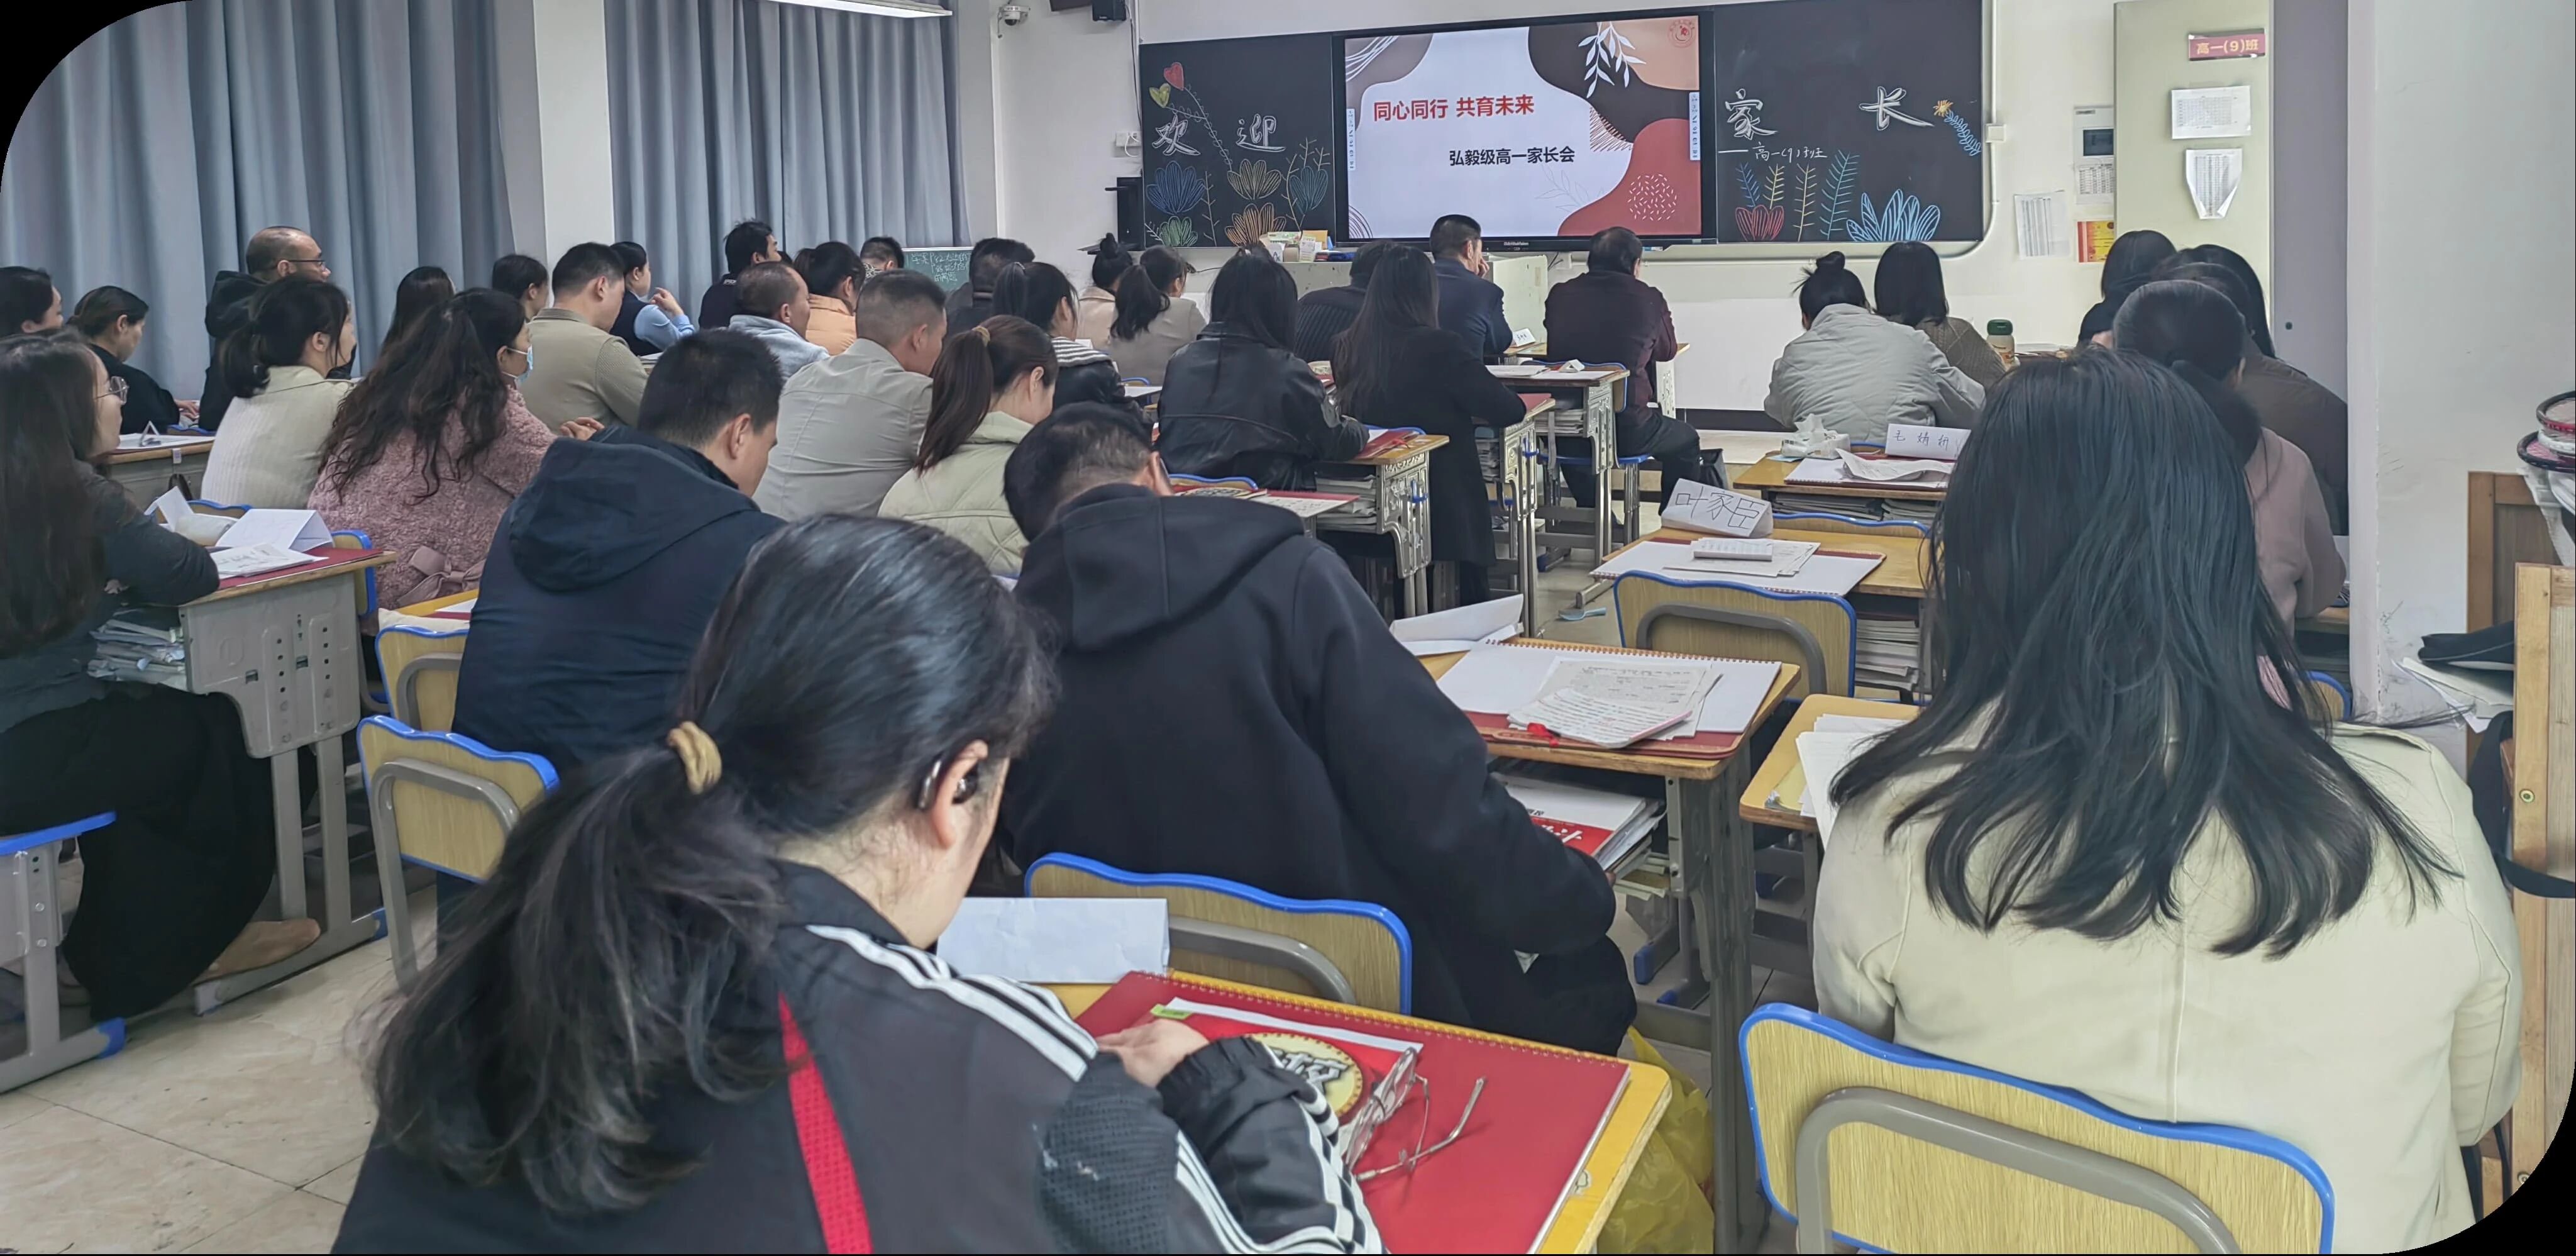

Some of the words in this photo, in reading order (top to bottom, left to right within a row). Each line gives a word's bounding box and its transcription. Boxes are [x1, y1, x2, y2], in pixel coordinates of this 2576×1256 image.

[2196, 38, 2259, 55] 高一(9)班
[1374, 99, 1449, 121] 同心同行
[1456, 94, 1535, 118] 共育未来
[1152, 114, 1286, 155] 欢迎
[1449, 146, 1575, 167] 弘毅级高一家长会
[1675, 486, 1766, 530] 叶家臣
